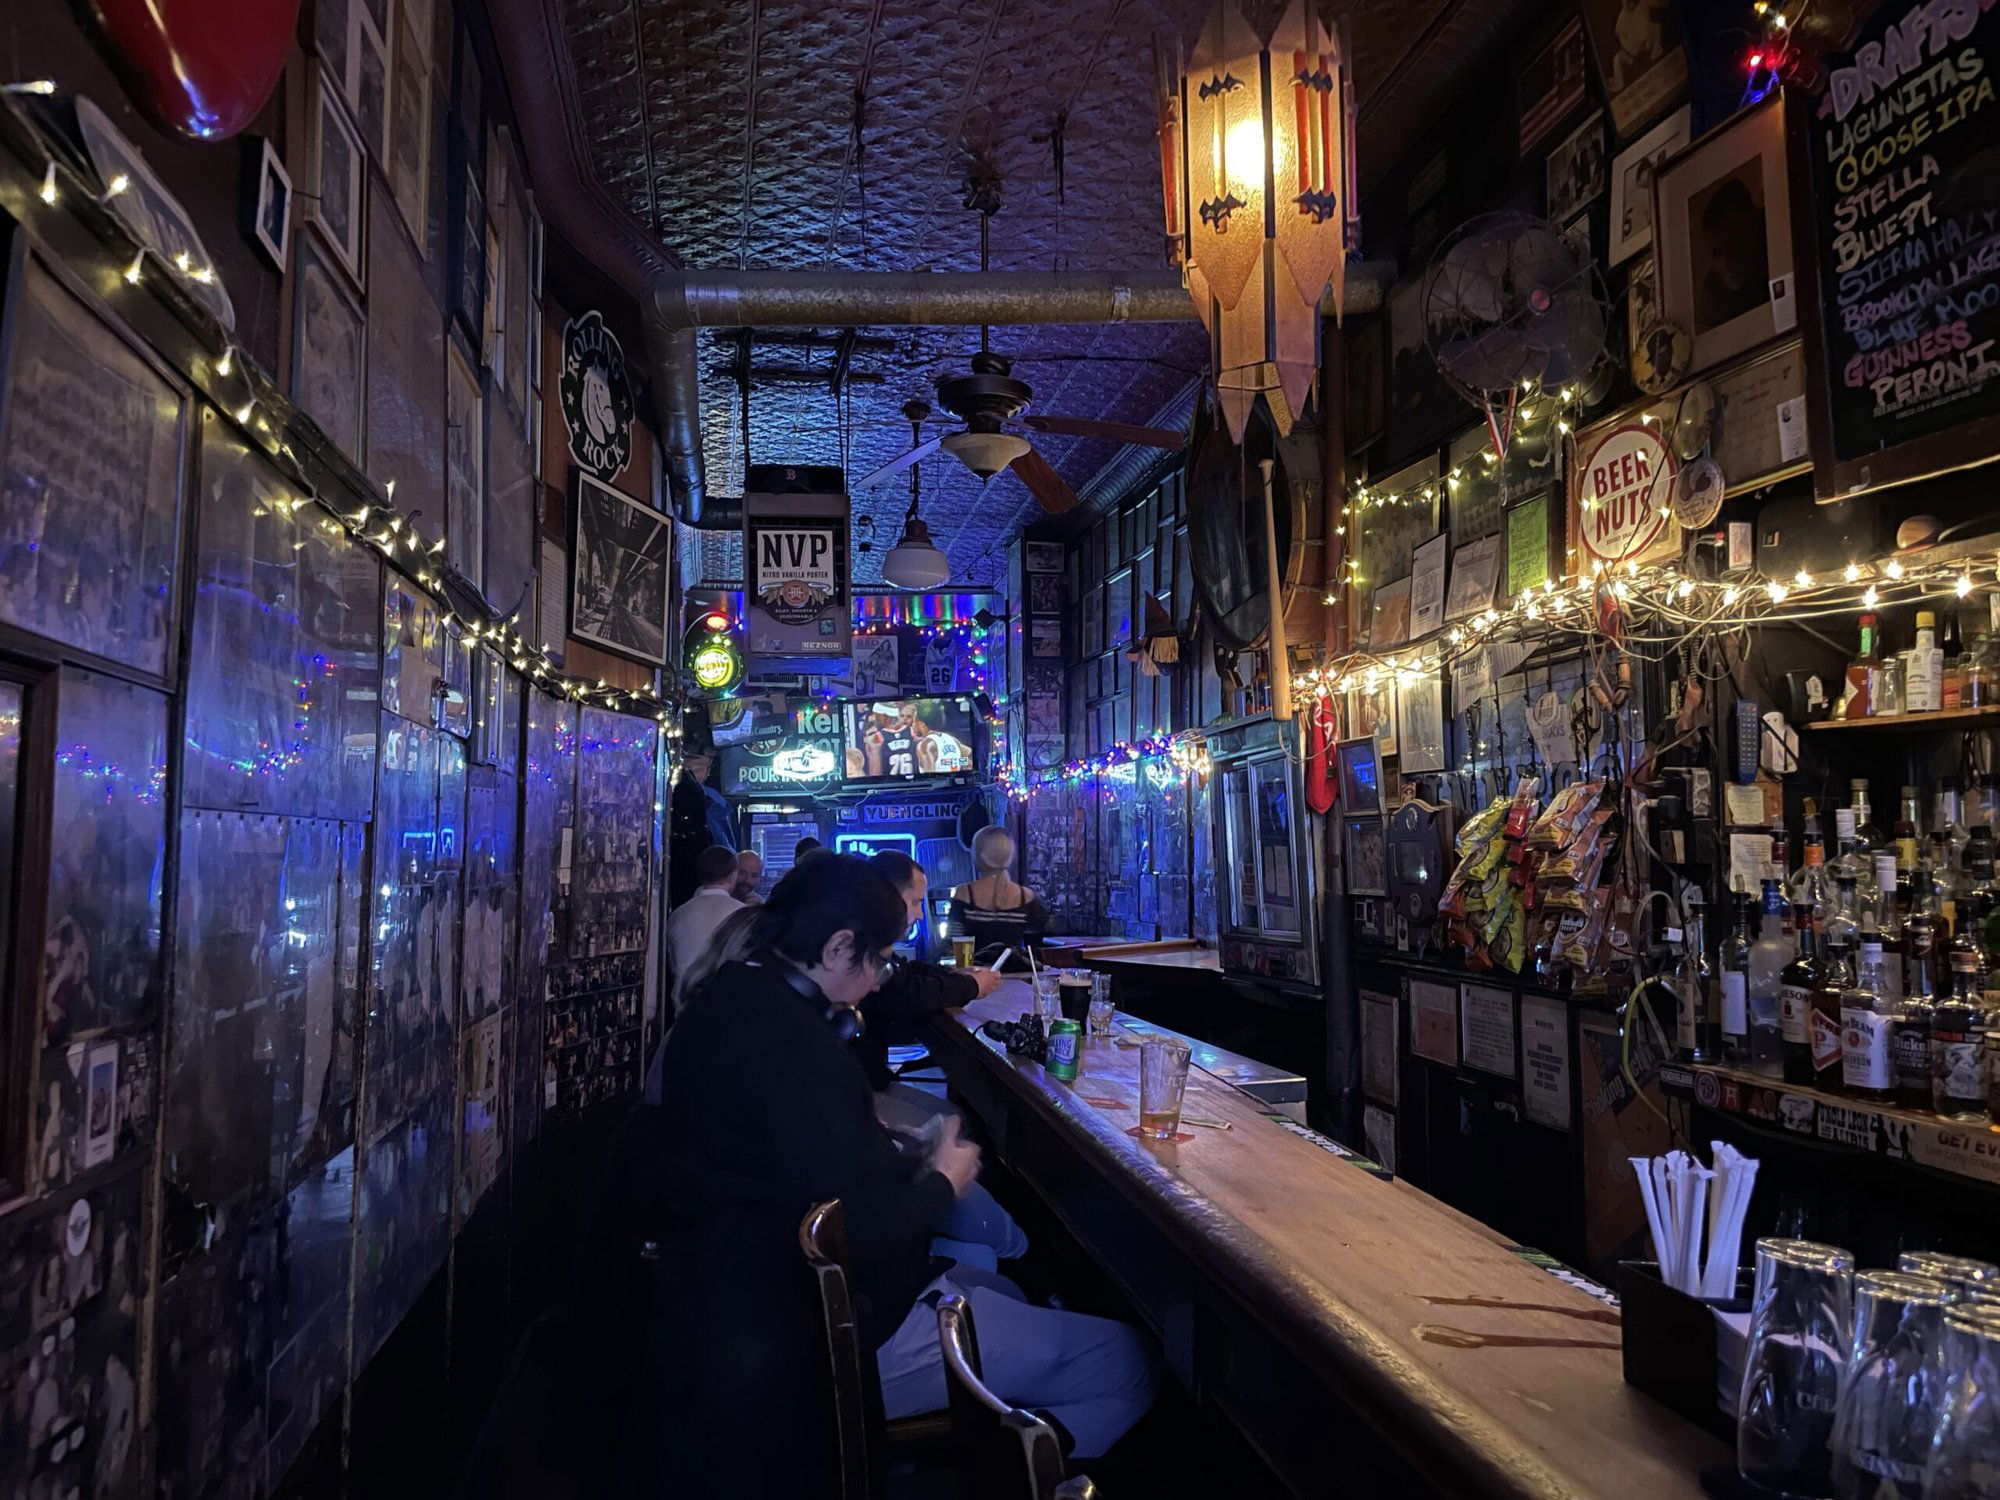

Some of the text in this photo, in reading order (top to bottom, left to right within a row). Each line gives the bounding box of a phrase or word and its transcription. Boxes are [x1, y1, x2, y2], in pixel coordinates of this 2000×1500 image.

[1829, 0, 1980, 122] DRAFTS
[1826, 47, 1984, 163] LAGUNITAS
[1835, 75, 1997, 193] GOOSE IPA
[1832, 153, 1941, 232] STELLA
[1832, 212, 1903, 273] BLUE
[567, 326, 621, 382] ROLLING
[1843, 319, 1974, 389] GUINNESS
[1869, 339, 1996, 407] PERONI
[583, 432, 624, 470] ROCK
[1593, 448, 1651, 499] BEER
[1596, 485, 1651, 543] NUTS
[762, 534, 828, 568] NVP
[931, 667, 950, 684] 26
[866, 804, 961, 820] YUENGLING
[1850, 1017, 1875, 1038] BEAM
[1819, 1103, 1846, 1127] UNCLE
[1847, 1109, 1869, 1134] LEON
[1938, 1130, 2000, 1159] GET EV
